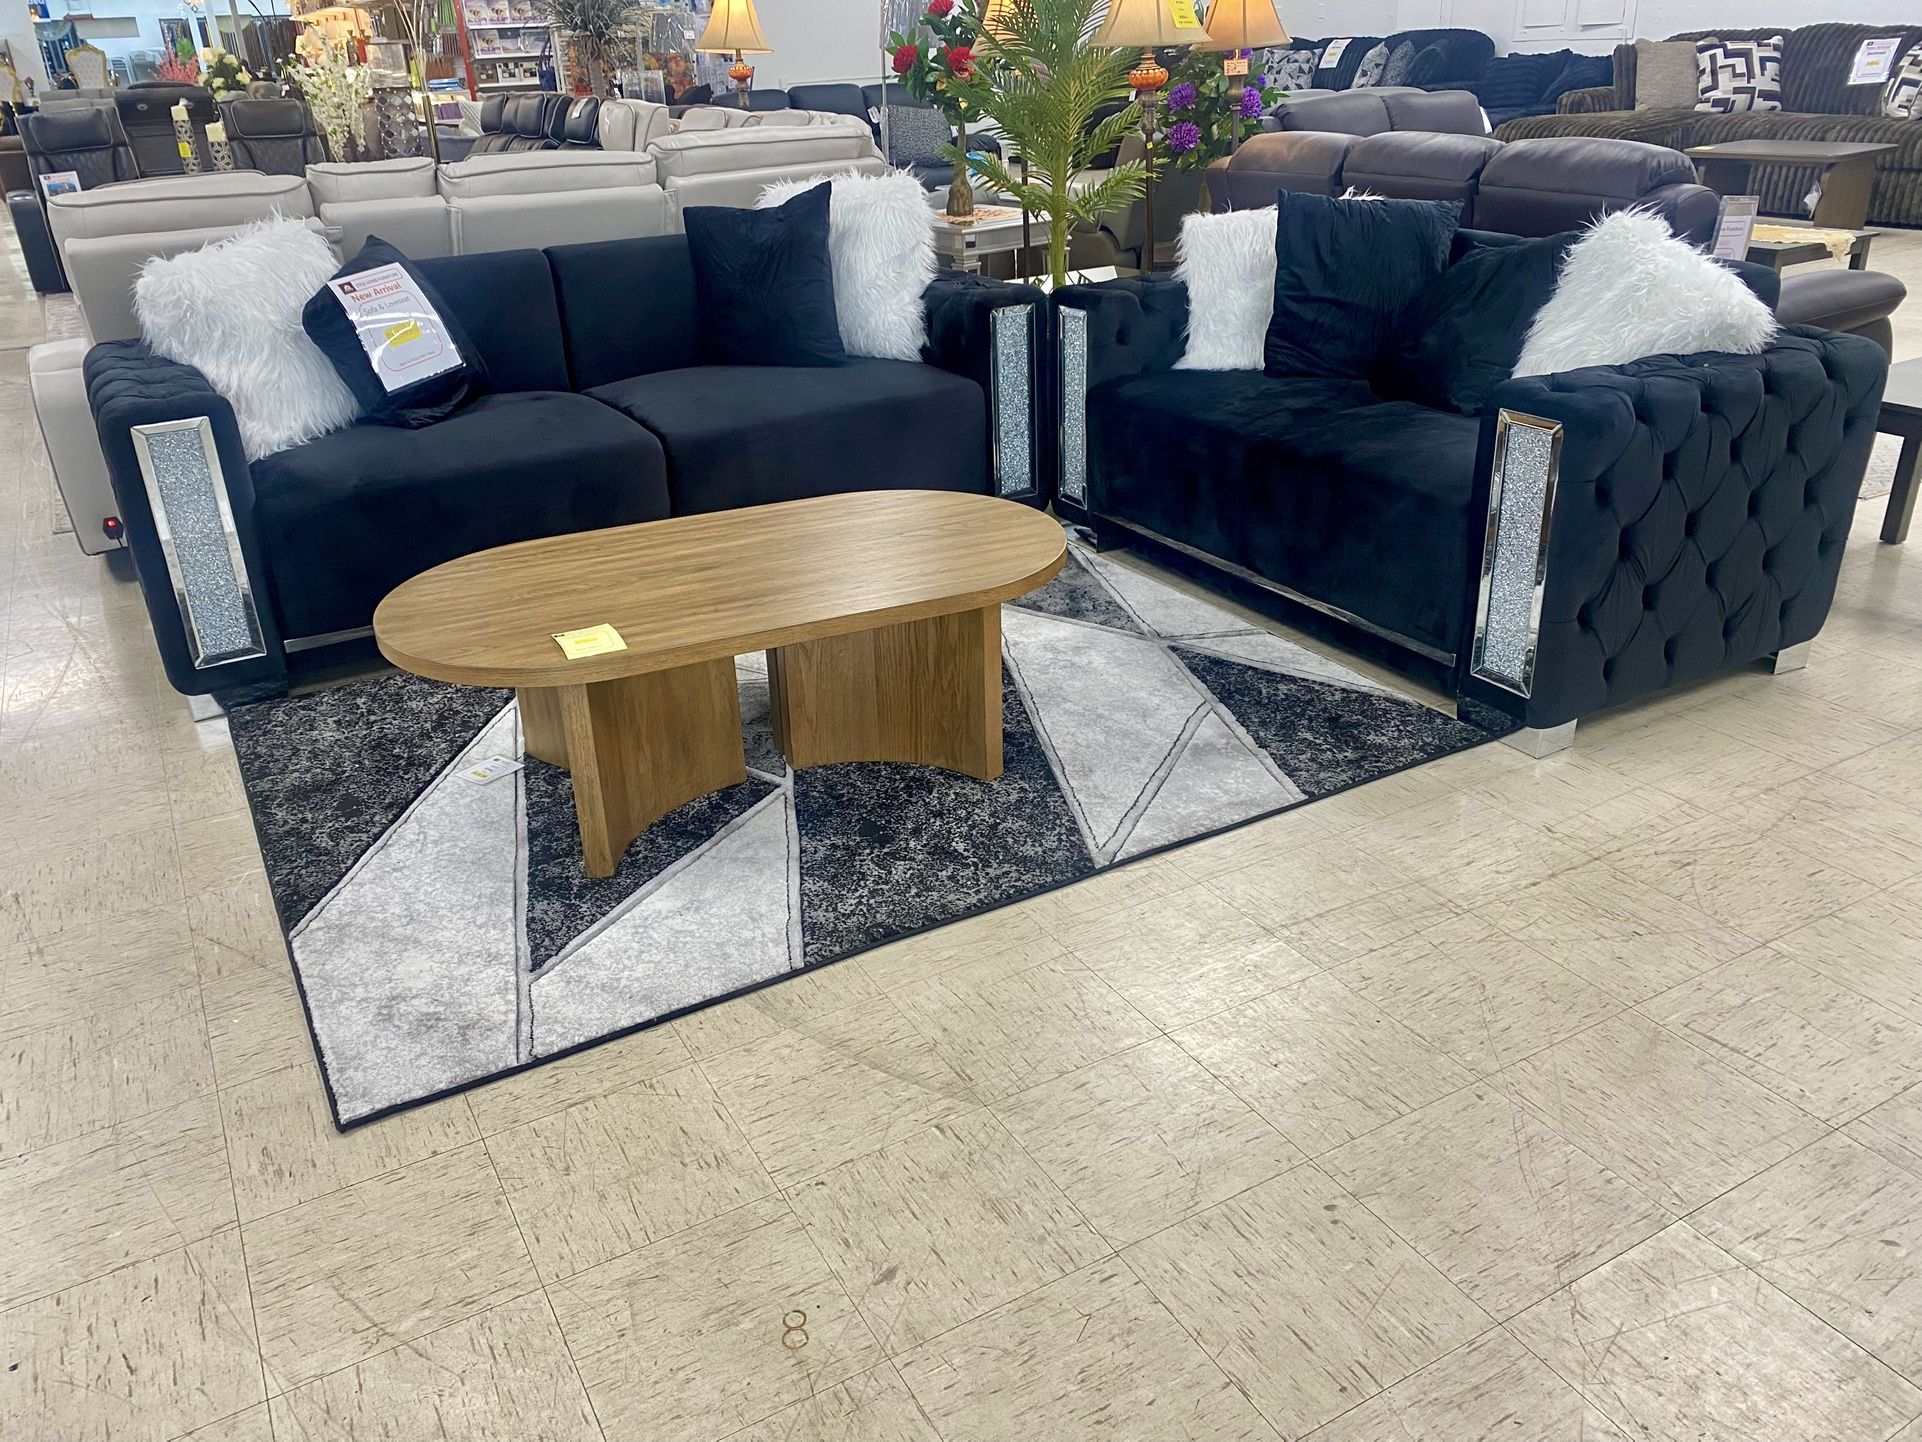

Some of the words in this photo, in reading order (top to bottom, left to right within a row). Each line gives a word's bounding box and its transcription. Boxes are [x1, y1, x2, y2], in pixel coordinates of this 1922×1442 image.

[351, 291, 372, 303] New
[373, 281, 402, 297] Arrival
[362, 304, 379, 316] Sofa
[379, 302, 386, 311] &
